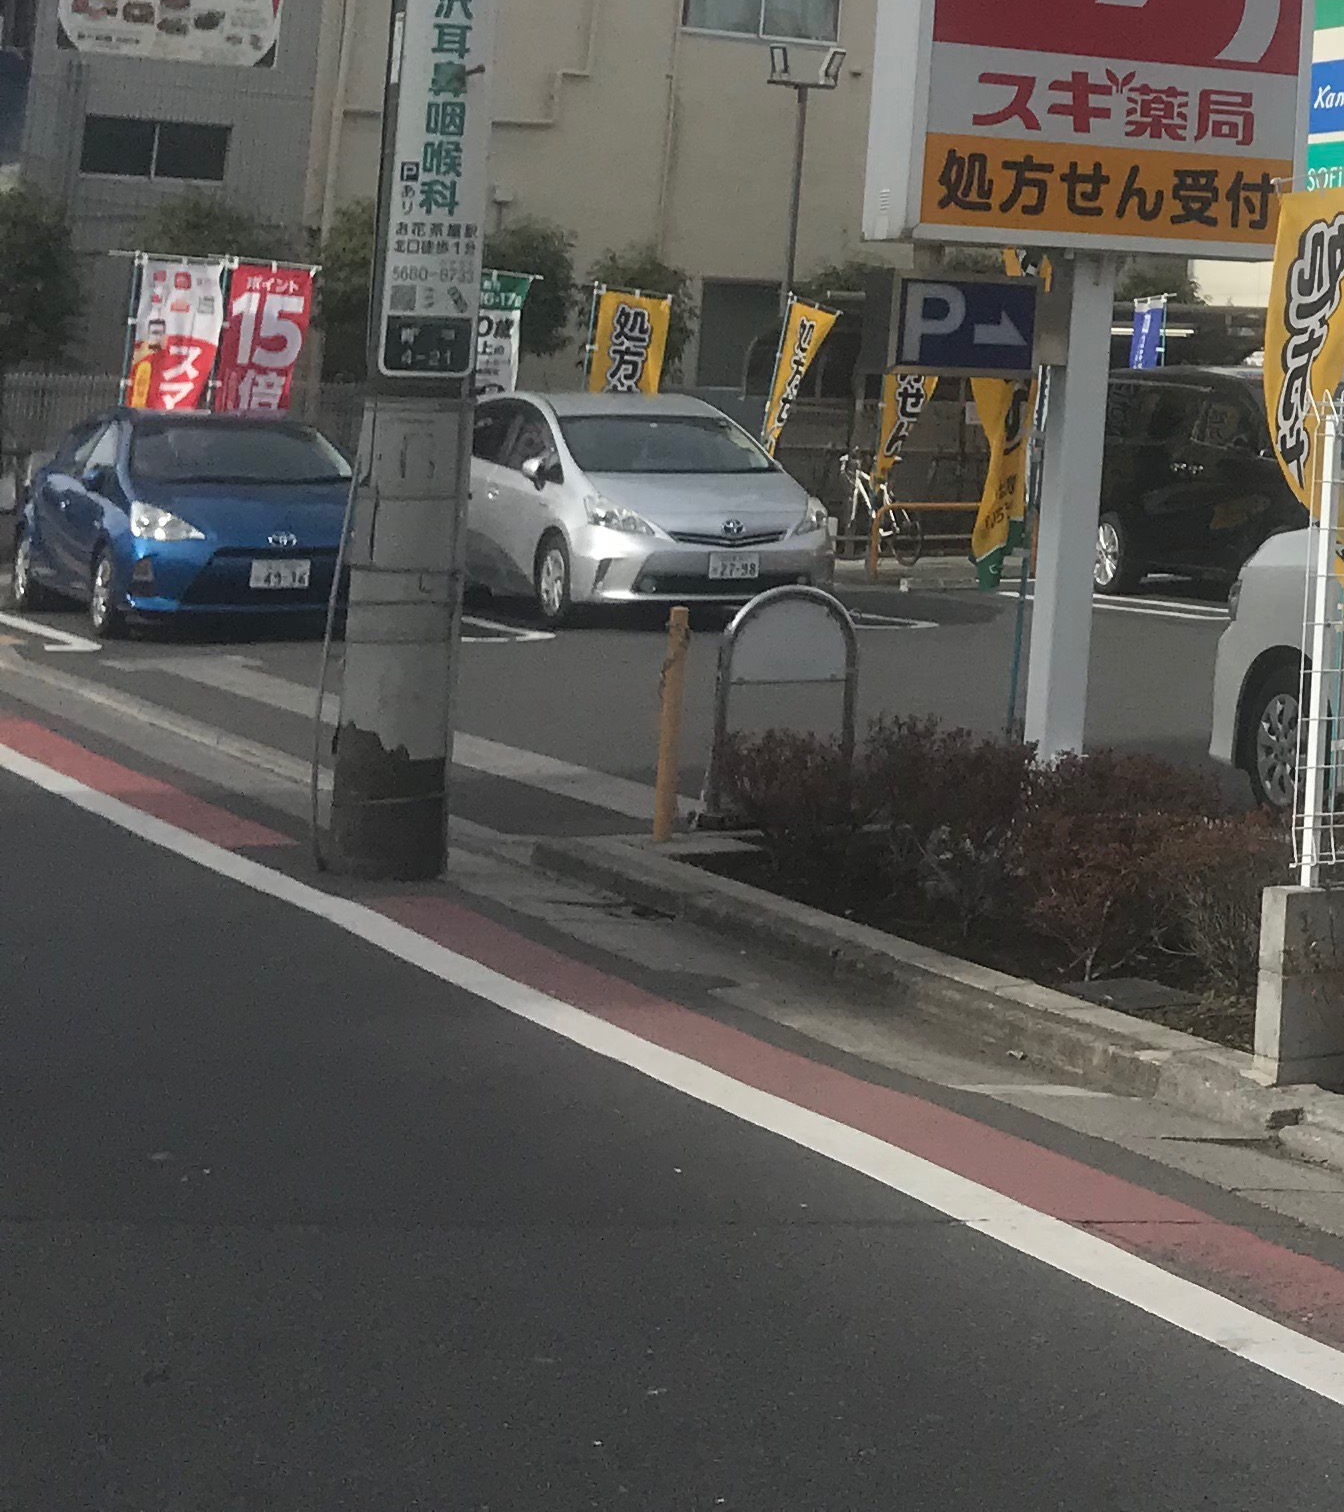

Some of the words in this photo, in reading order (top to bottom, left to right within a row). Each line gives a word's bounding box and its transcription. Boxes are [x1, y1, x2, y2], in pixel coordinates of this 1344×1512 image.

[972, 68, 1255, 146] スギ薬局
[937, 148, 1276, 231] 処方せん受付
[246, 275, 300, 294] ポイント
[231, 291, 305, 368] 15
[904, 288, 967, 364] P
